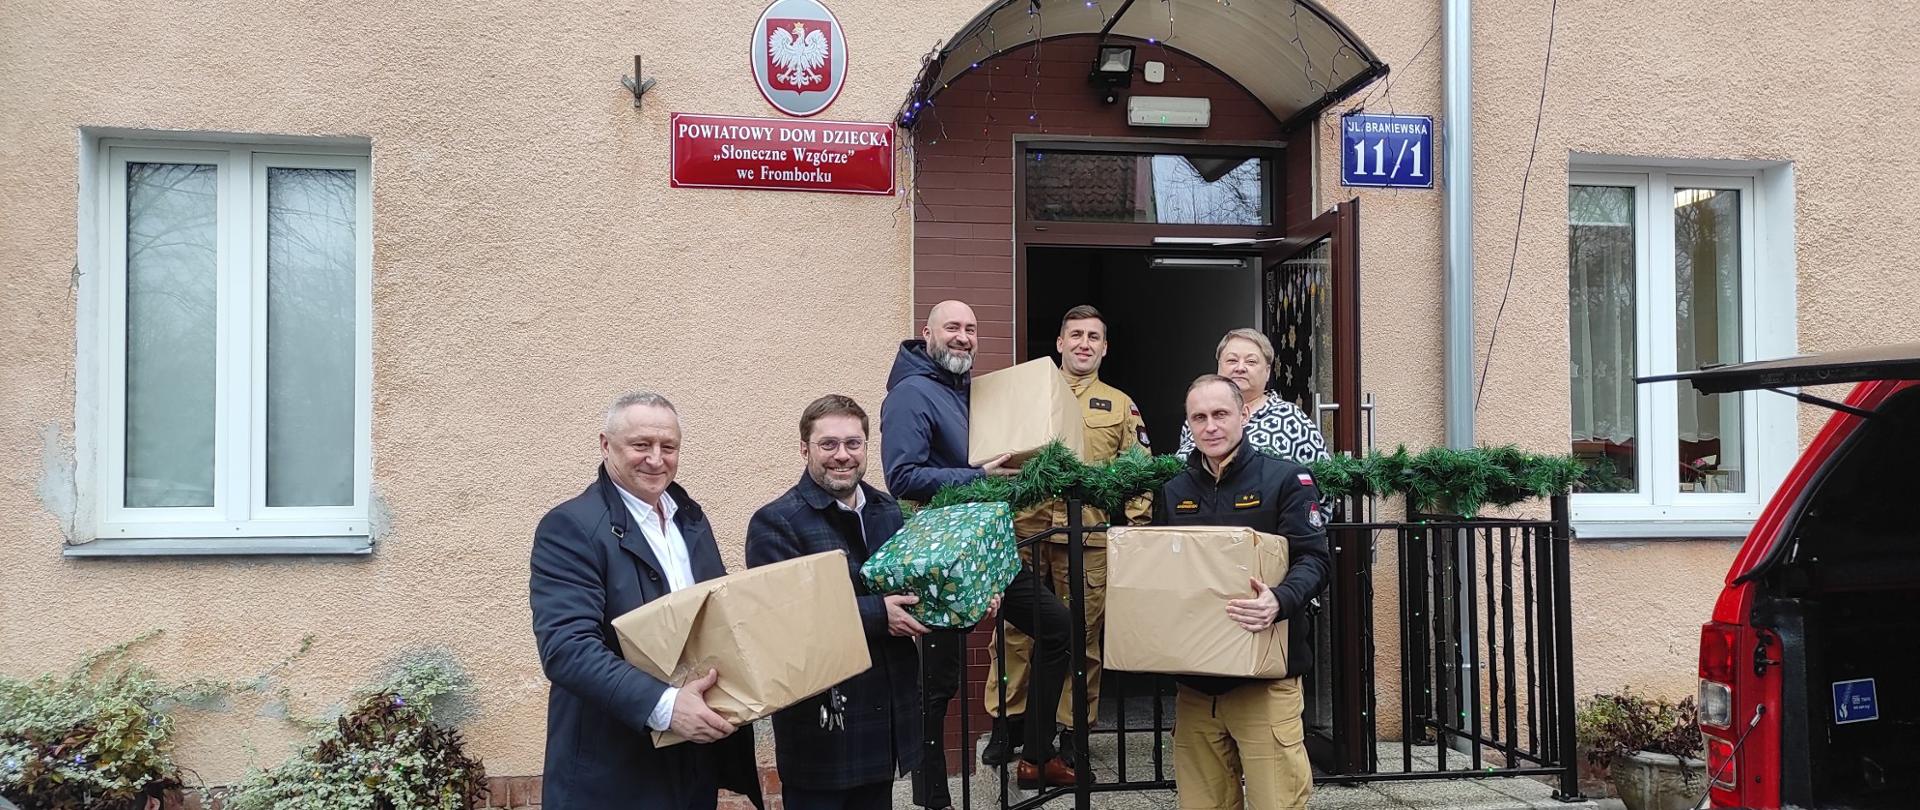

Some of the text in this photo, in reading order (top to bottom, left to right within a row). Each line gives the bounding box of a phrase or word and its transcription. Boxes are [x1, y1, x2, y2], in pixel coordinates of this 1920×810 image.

[678, 123, 889, 147] POWIATOWY DOM DZIECKA
[1365, 122, 1428, 135] BRANIEWSKA
[713, 144, 855, 166] „Słoneczne Wzgórze”
[1353, 138, 1424, 179] 11/1
[736, 165, 832, 183] we Fromborku
